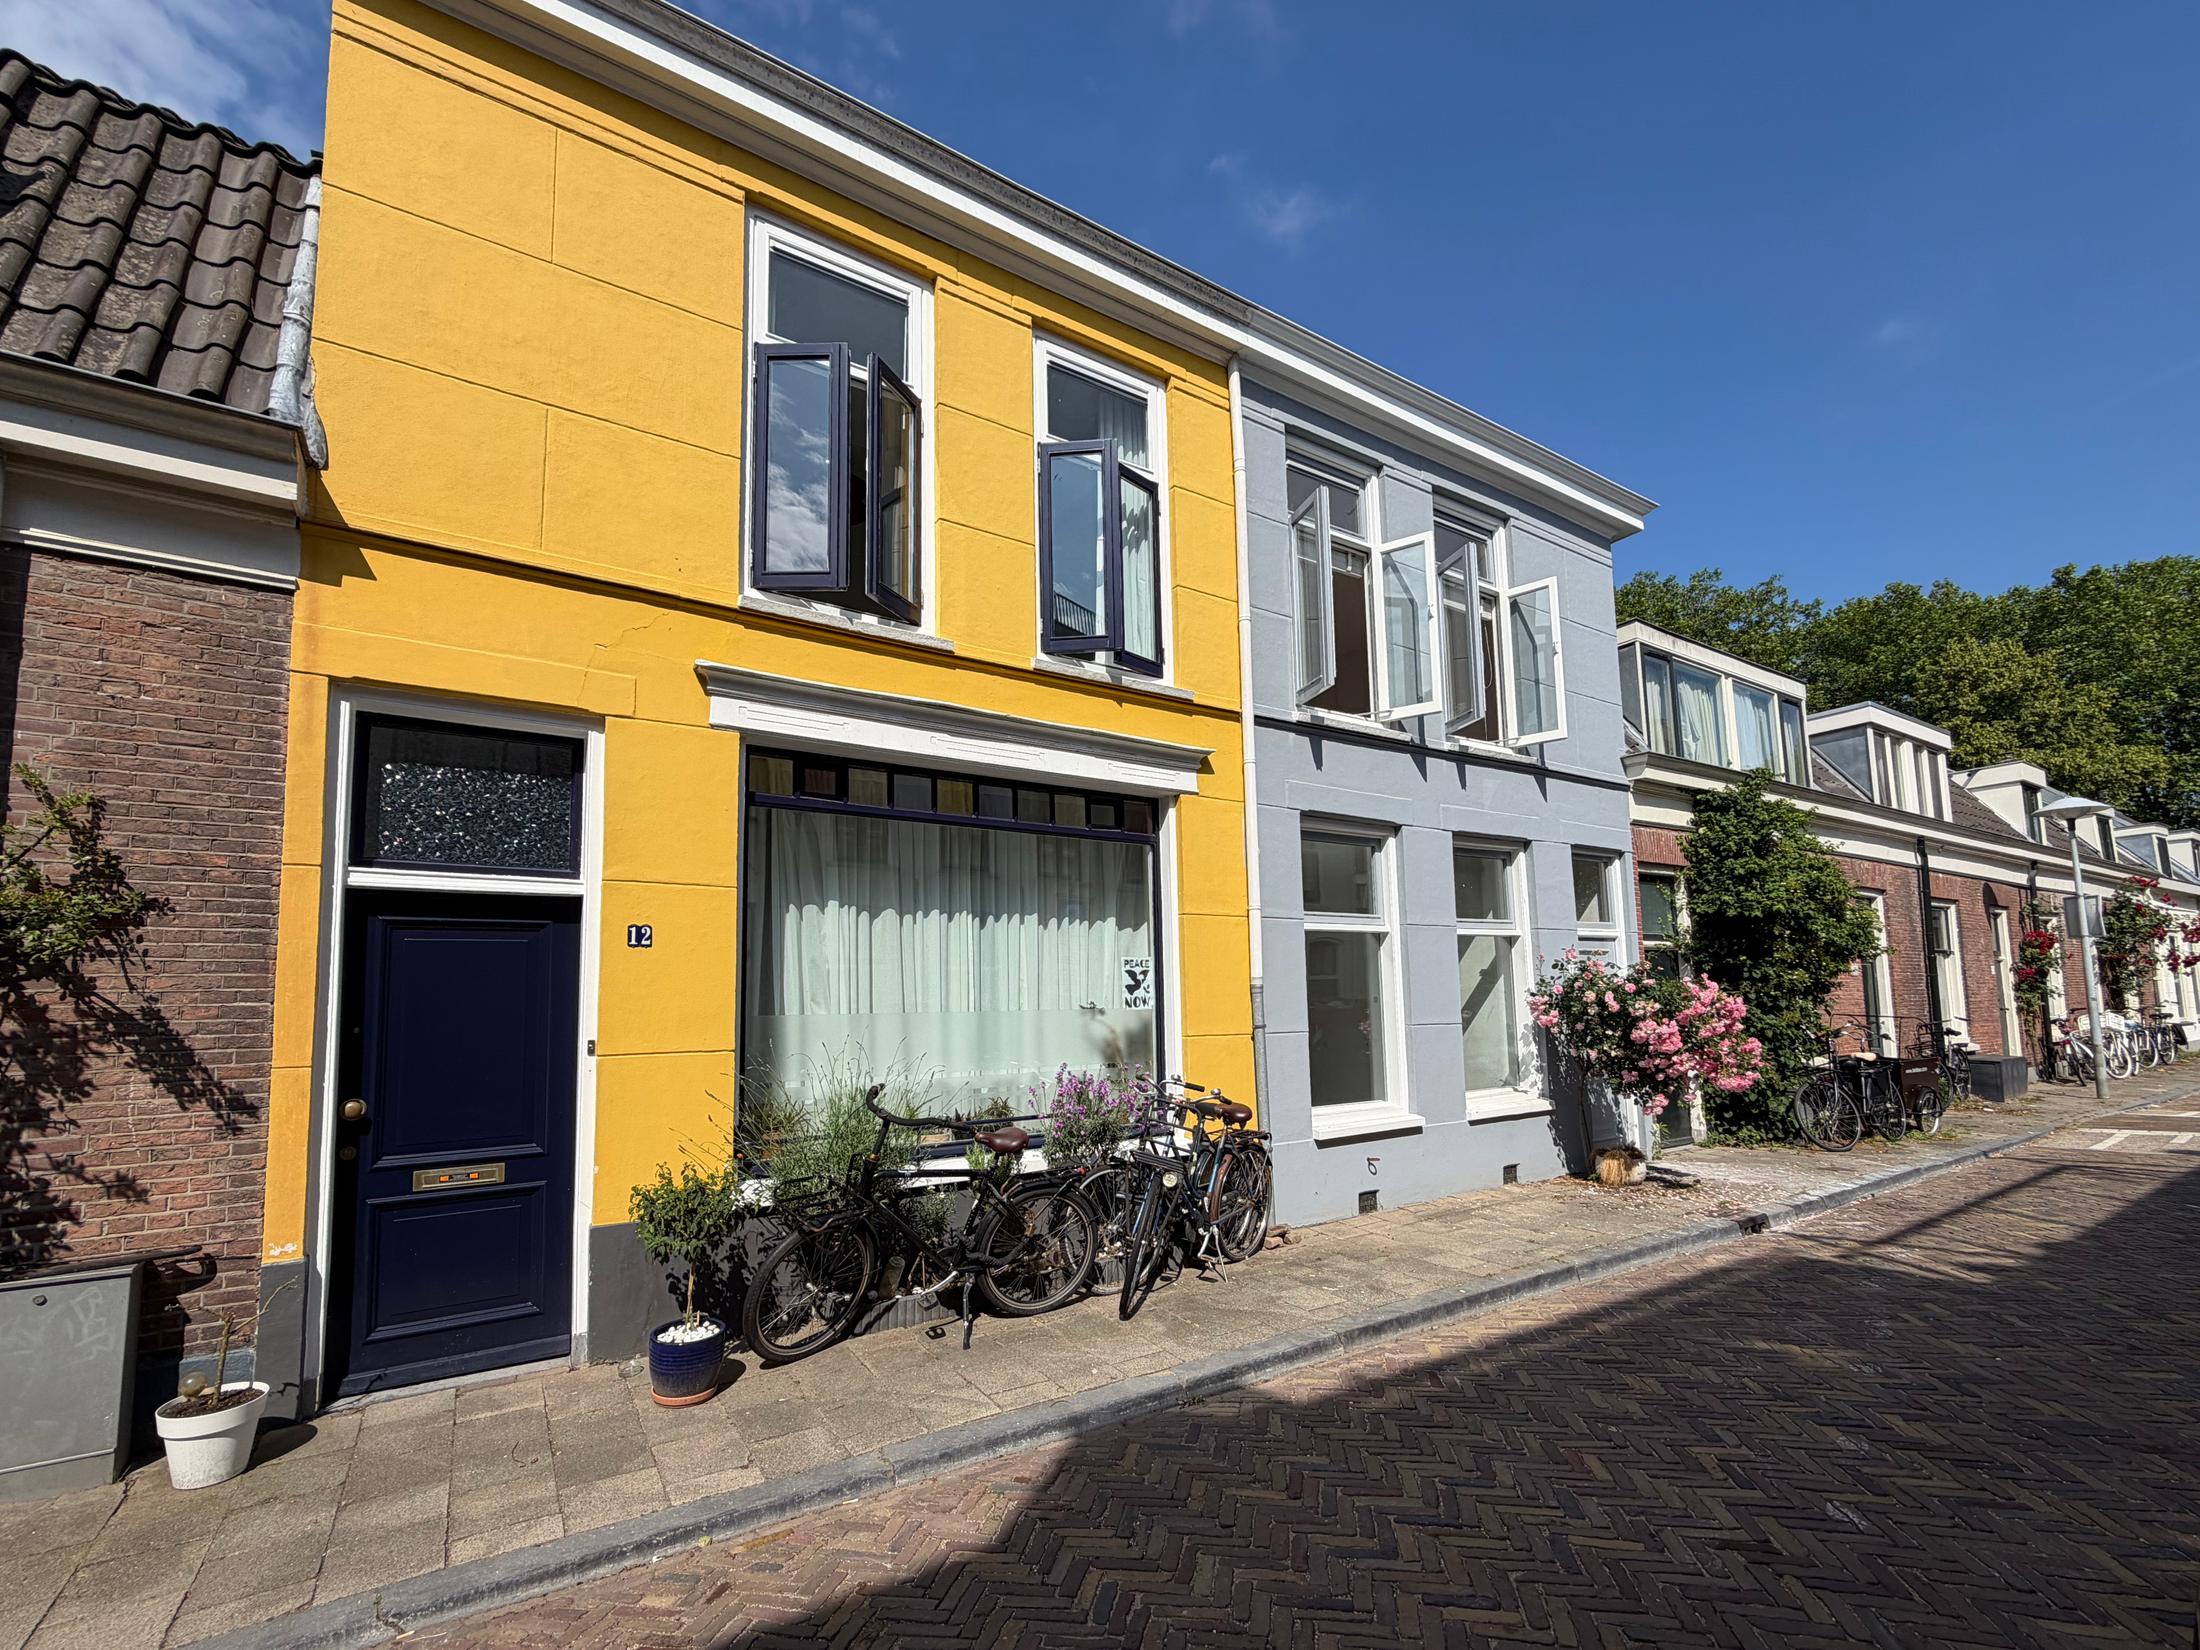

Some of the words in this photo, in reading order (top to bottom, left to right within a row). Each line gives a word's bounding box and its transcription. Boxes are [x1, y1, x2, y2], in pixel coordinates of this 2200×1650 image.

[629, 926, 651, 945] 12
[1123, 959, 1150, 968] PEACE
[1125, 996, 1151, 1008] NOW
